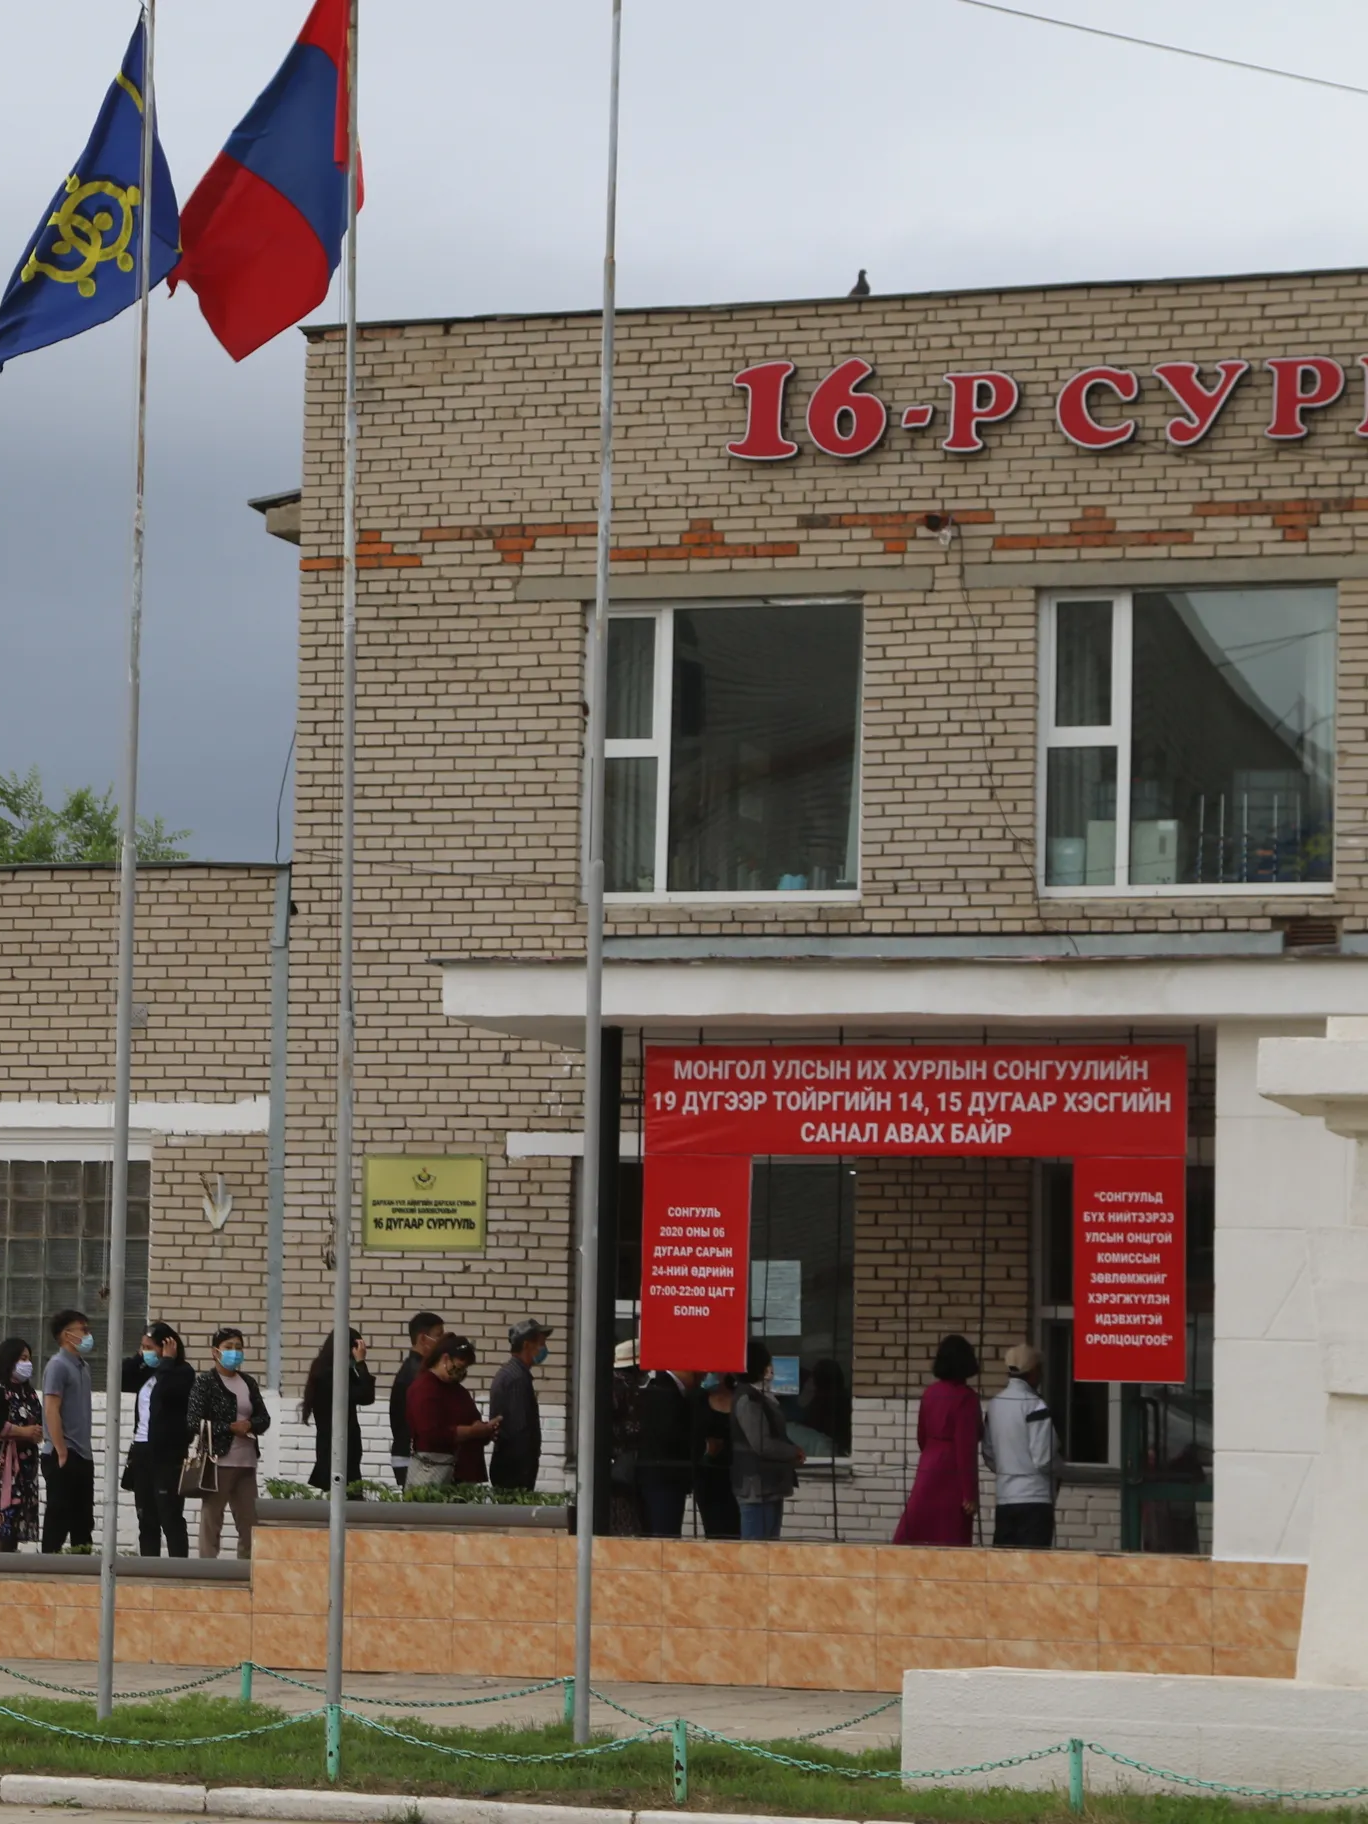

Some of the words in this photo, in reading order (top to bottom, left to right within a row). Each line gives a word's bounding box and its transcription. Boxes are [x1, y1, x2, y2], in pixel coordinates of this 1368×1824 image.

[1055, 355, 1368, 450] СУР
[674, 1060, 766, 1079] МОНГОЛ
[773, 1060, 850, 1079] УЛСЫН
[857, 1061, 886, 1079] ИХ
[893, 1061, 986, 1080] ХУРЛЫН
[993, 1055, 1148, 1080] СОНГУУЛИЙН
[653, 1091, 676, 1110] 19
[682, 1092, 767, 1115] ДҮГЭЭР
[773, 1087, 891, 1111] ТОЙРГИЙН
[899, 1092, 930, 1115] 14,
[938, 1093, 962, 1111] 15
[968, 1092, 1057, 1115] ДУГААР
[1064, 1087, 1171, 1112] ХЭСГИЙН
[801, 1122, 878, 1143] САНАЛ
[884, 1123, 944, 1143] АВАХ
[951, 1119, 1011, 1143] БАЙР
[668, 1207, 721, 1217] СОНГУУЛЬ
[1084, 1212, 1105, 1222] БҮХ
[1108, 1211, 1174, 1223] НИЙТЭЭРЭЭ
[385, 1218, 424, 1231] ДУГААР
[426, 1218, 476, 1230] СУРГУУЛЬ
[660, 1226, 683, 1236] 2020
[686, 1227, 710, 1237] ОНЫ
[713, 1228, 725, 1237] 06
[1086, 1232, 1124, 1243] УЛСЫН
[1127, 1231, 1172, 1244] ОНЦГОЙ
[654, 1246, 693, 1257] ДУГААР
[696, 1247, 732, 1257] САРЫН
[1097, 1253, 1160, 1263] КОМИССЫН
[652, 1265, 688, 1276] 24-НИЙ
[691, 1266, 734, 1277] ӨДРИЙН
[1091, 1273, 1167, 1284] ЗӨВЛӨМЖИЙГ
[650, 1285, 705, 1296] 07:00-22:00
[708, 1287, 735, 1298] ЦАГТ
[1088, 1294, 1169, 1304] ХЭРЭГЖҮҮЛЭН
[674, 1306, 709, 1316] БОЛНО
[1096, 1313, 1162, 1325] ИДЭВХИТЭЙ
